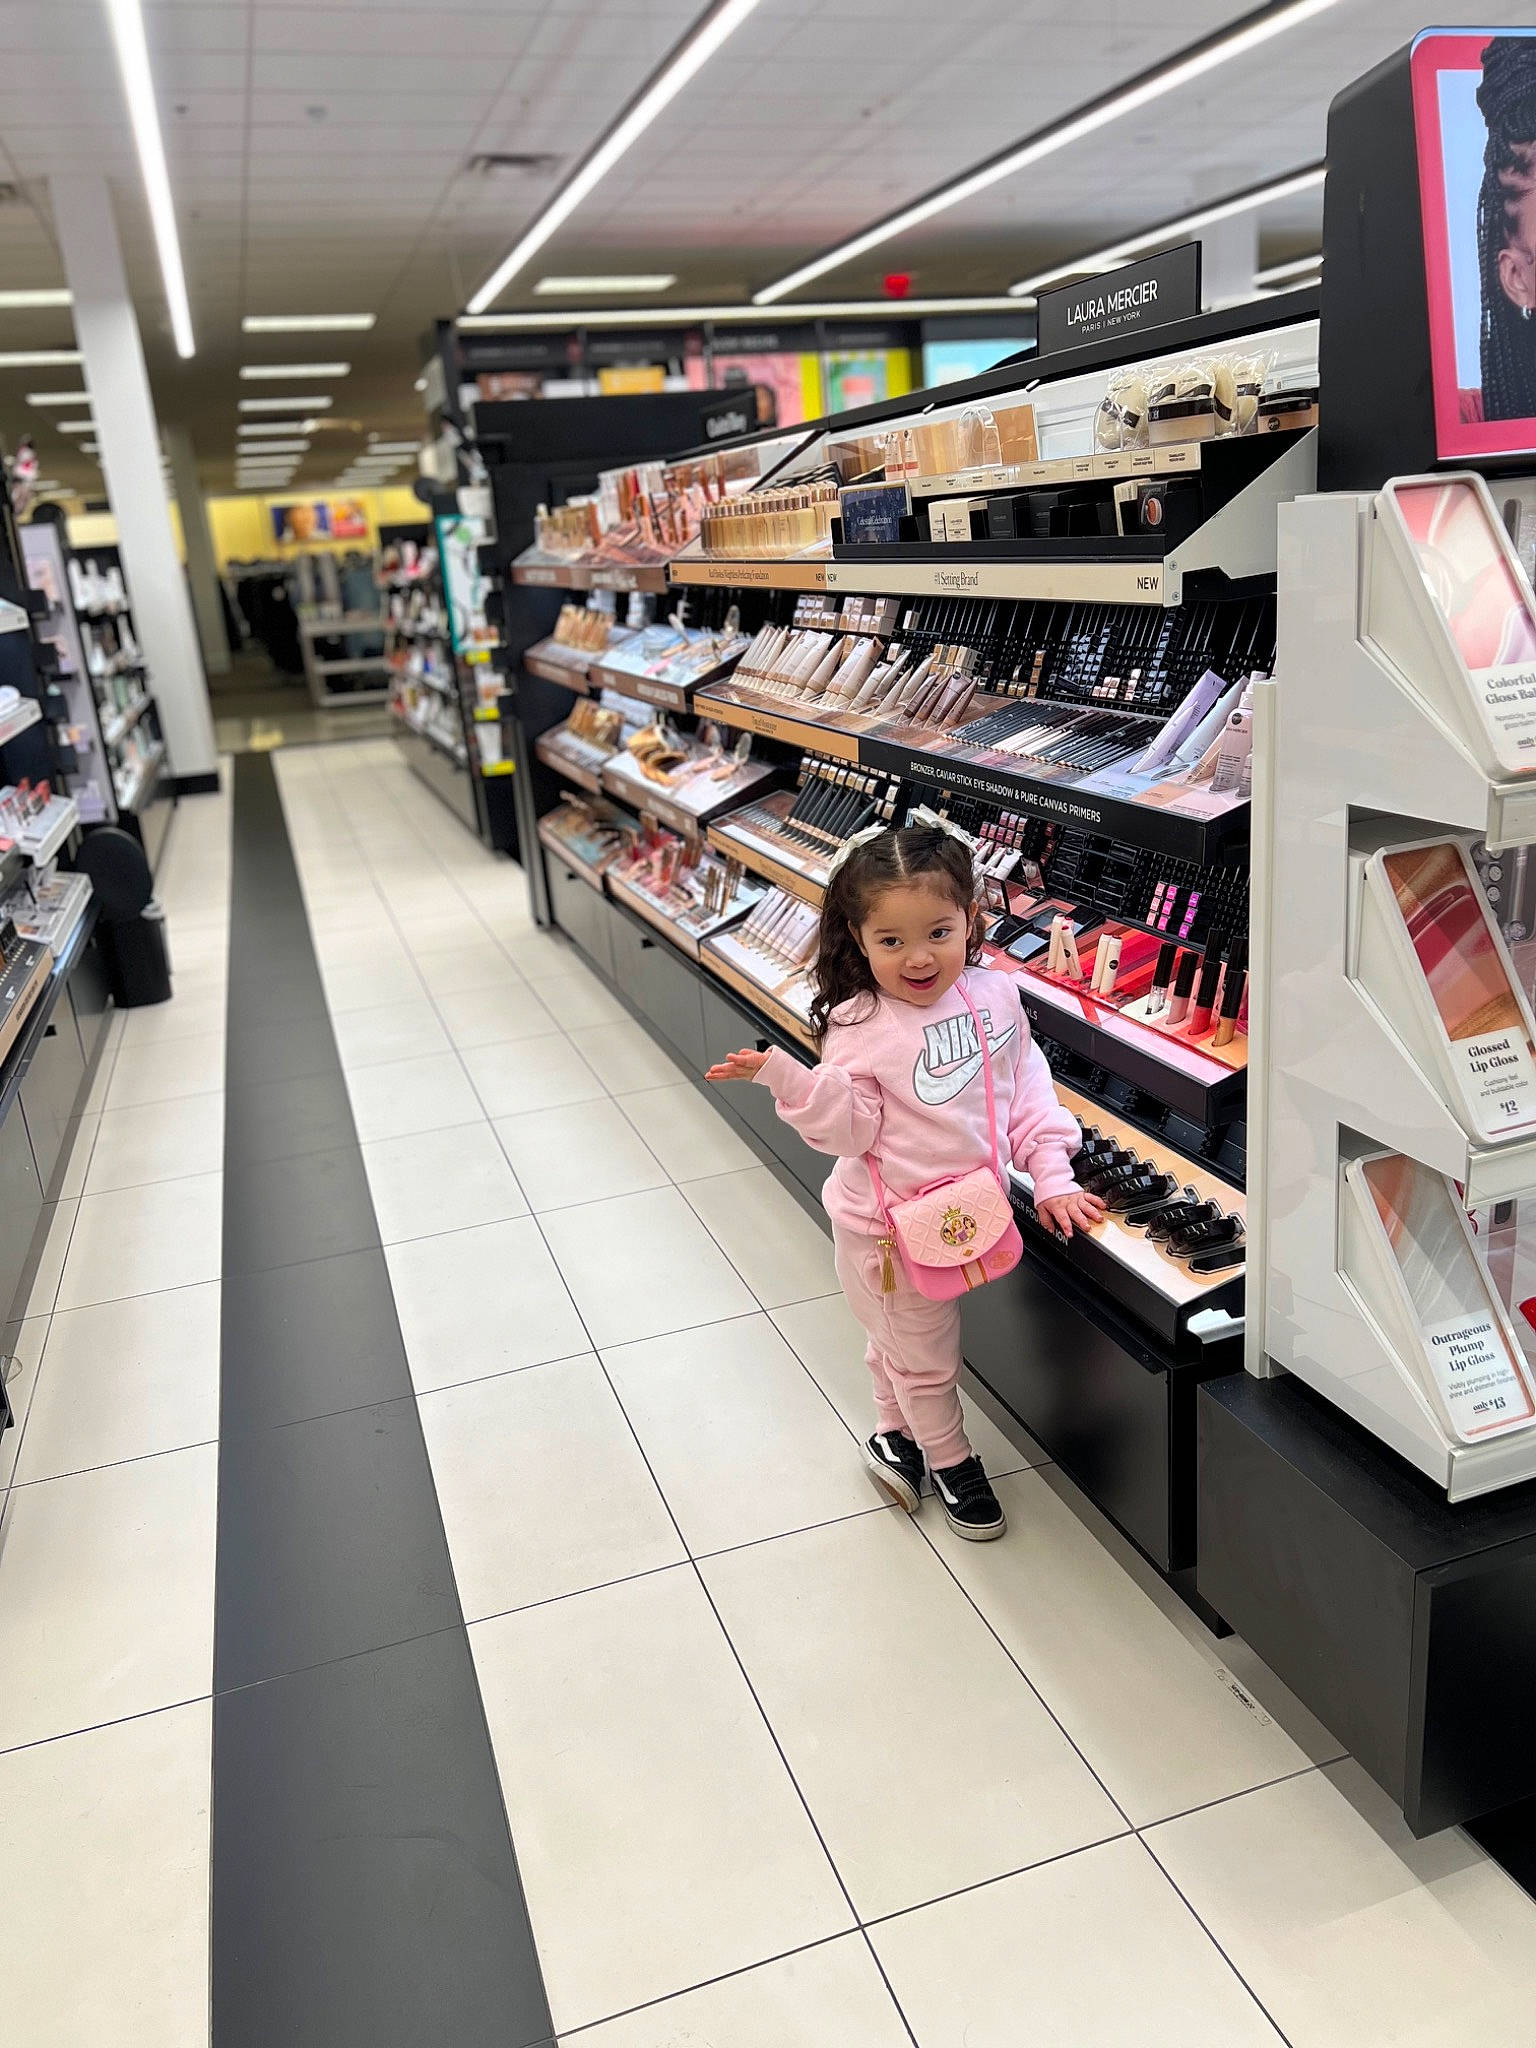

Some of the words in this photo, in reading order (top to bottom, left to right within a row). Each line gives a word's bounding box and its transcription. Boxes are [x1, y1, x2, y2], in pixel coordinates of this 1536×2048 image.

[1067, 299, 1106, 326] LAURA
[1107, 279, 1158, 315] MERCIER
[1081, 322, 1101, 334] PARIS
[1107, 317, 1122, 327] NEW
[1122, 310, 1142, 323] YORK
[941, 571, 960, 588] Setting
[961, 571, 979, 586] Brand
[1137, 576, 1159, 590] NEW
[1485, 693, 1518, 704] Gloss
[936, 769, 957, 783] CAVIAR
[957, 773, 973, 787] STICK
[973, 778, 986, 791] EYE
[986, 782, 1014, 799] SHADOW
[1014, 789, 1020, 800] &
[1020, 791, 1039, 805] PURE
[1039, 796, 1068, 814] CANVAS
[1069, 804, 1101, 823] PRIMERS
[922, 1008, 994, 1071] NIKE
[1467, 1038, 1510, 1058] Glossed
[1469, 1060, 1489, 1073] Lip
[1488, 1053, 1519, 1069] Gloss
[1500, 1100, 1518, 1112] $12
[1431, 1322, 1492, 1346] Outrageous
[1448, 1340, 1485, 1356] Plump
[1448, 1357, 1467, 1372] Lip
[1468, 1351, 1496, 1366] Gloss
[1464, 1387, 1473, 1395] and
[1473, 1401, 1489, 1411] only
[1489, 1396, 1506, 1409] $13
